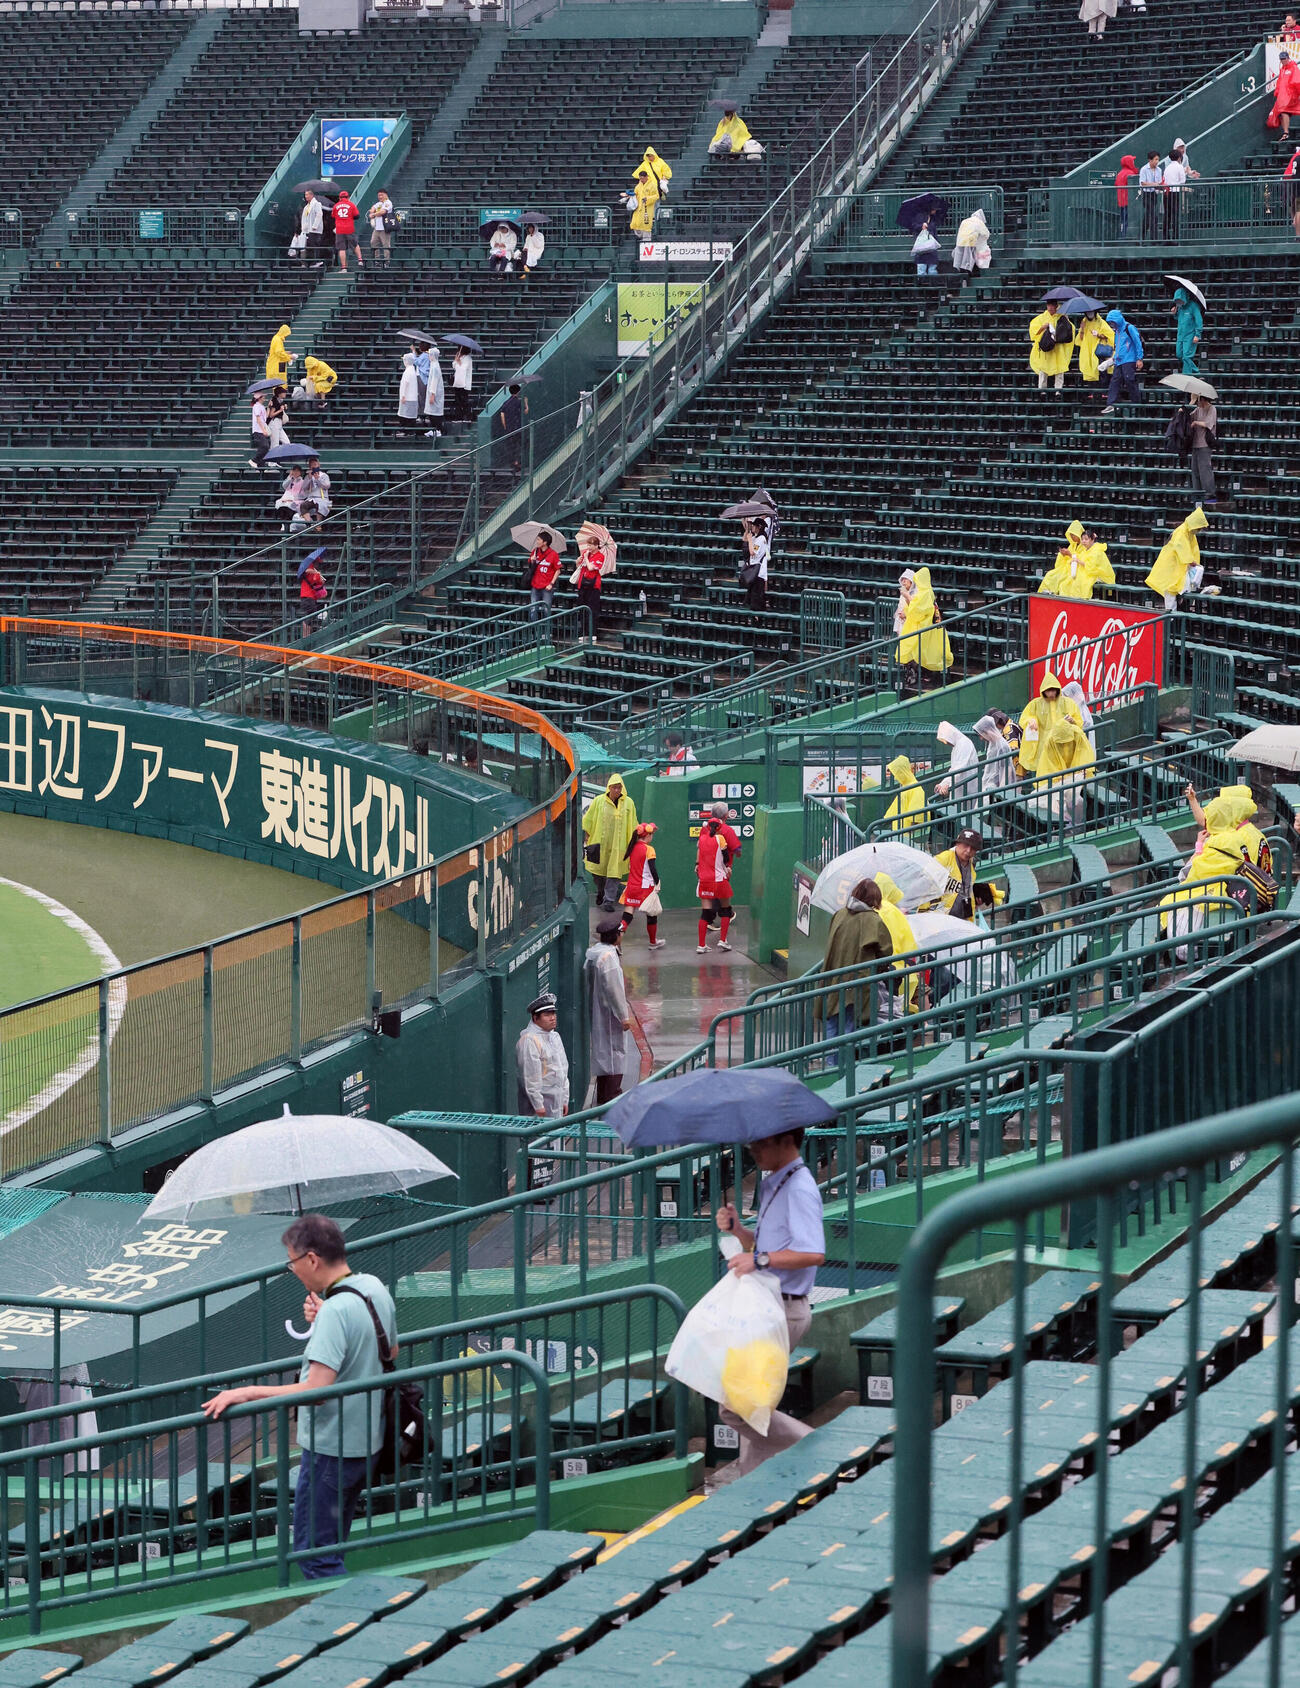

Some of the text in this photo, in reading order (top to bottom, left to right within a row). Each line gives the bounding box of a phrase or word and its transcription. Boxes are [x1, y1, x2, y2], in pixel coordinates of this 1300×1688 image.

[337, 208, 349, 218] 42
[0, 704, 239, 829] 田辺ファーマ
[259, 748, 435, 905] 東進ハイスクール
